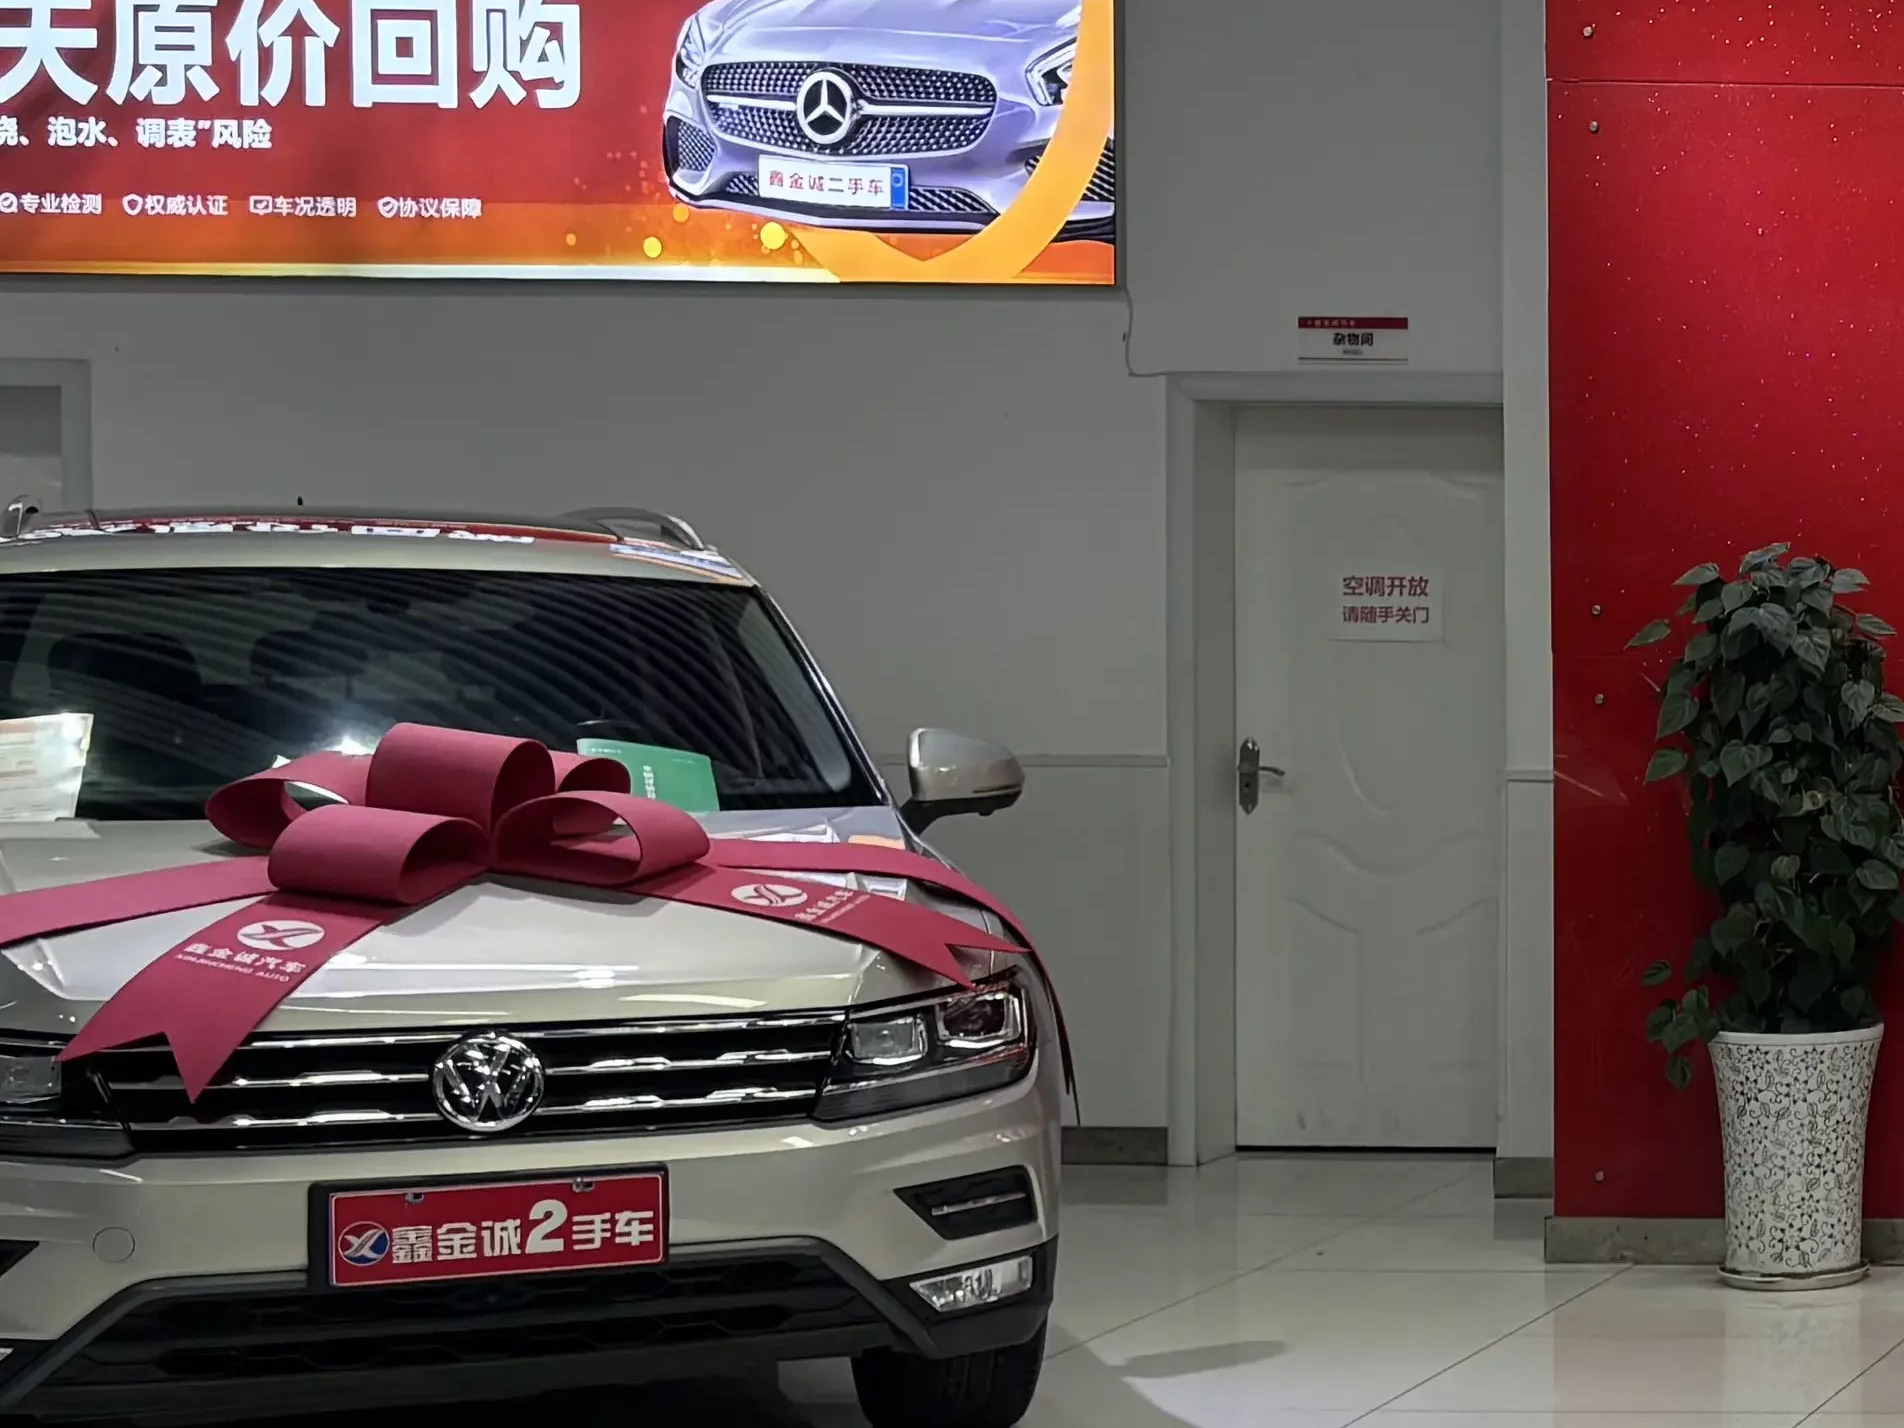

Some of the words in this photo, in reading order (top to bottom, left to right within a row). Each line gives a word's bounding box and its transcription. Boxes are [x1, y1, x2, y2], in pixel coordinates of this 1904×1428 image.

[19, 193, 102, 215] 专业检测
[145, 194, 229, 217] 权威认证
[273, 196, 357, 218] 车况透明
[399, 197, 483, 220] 协议保障
[1342, 575, 1429, 598] 空调开放
[1342, 605, 1430, 624] 请随手关门
[391, 1198, 654, 1264] 鑫金诚2手车
